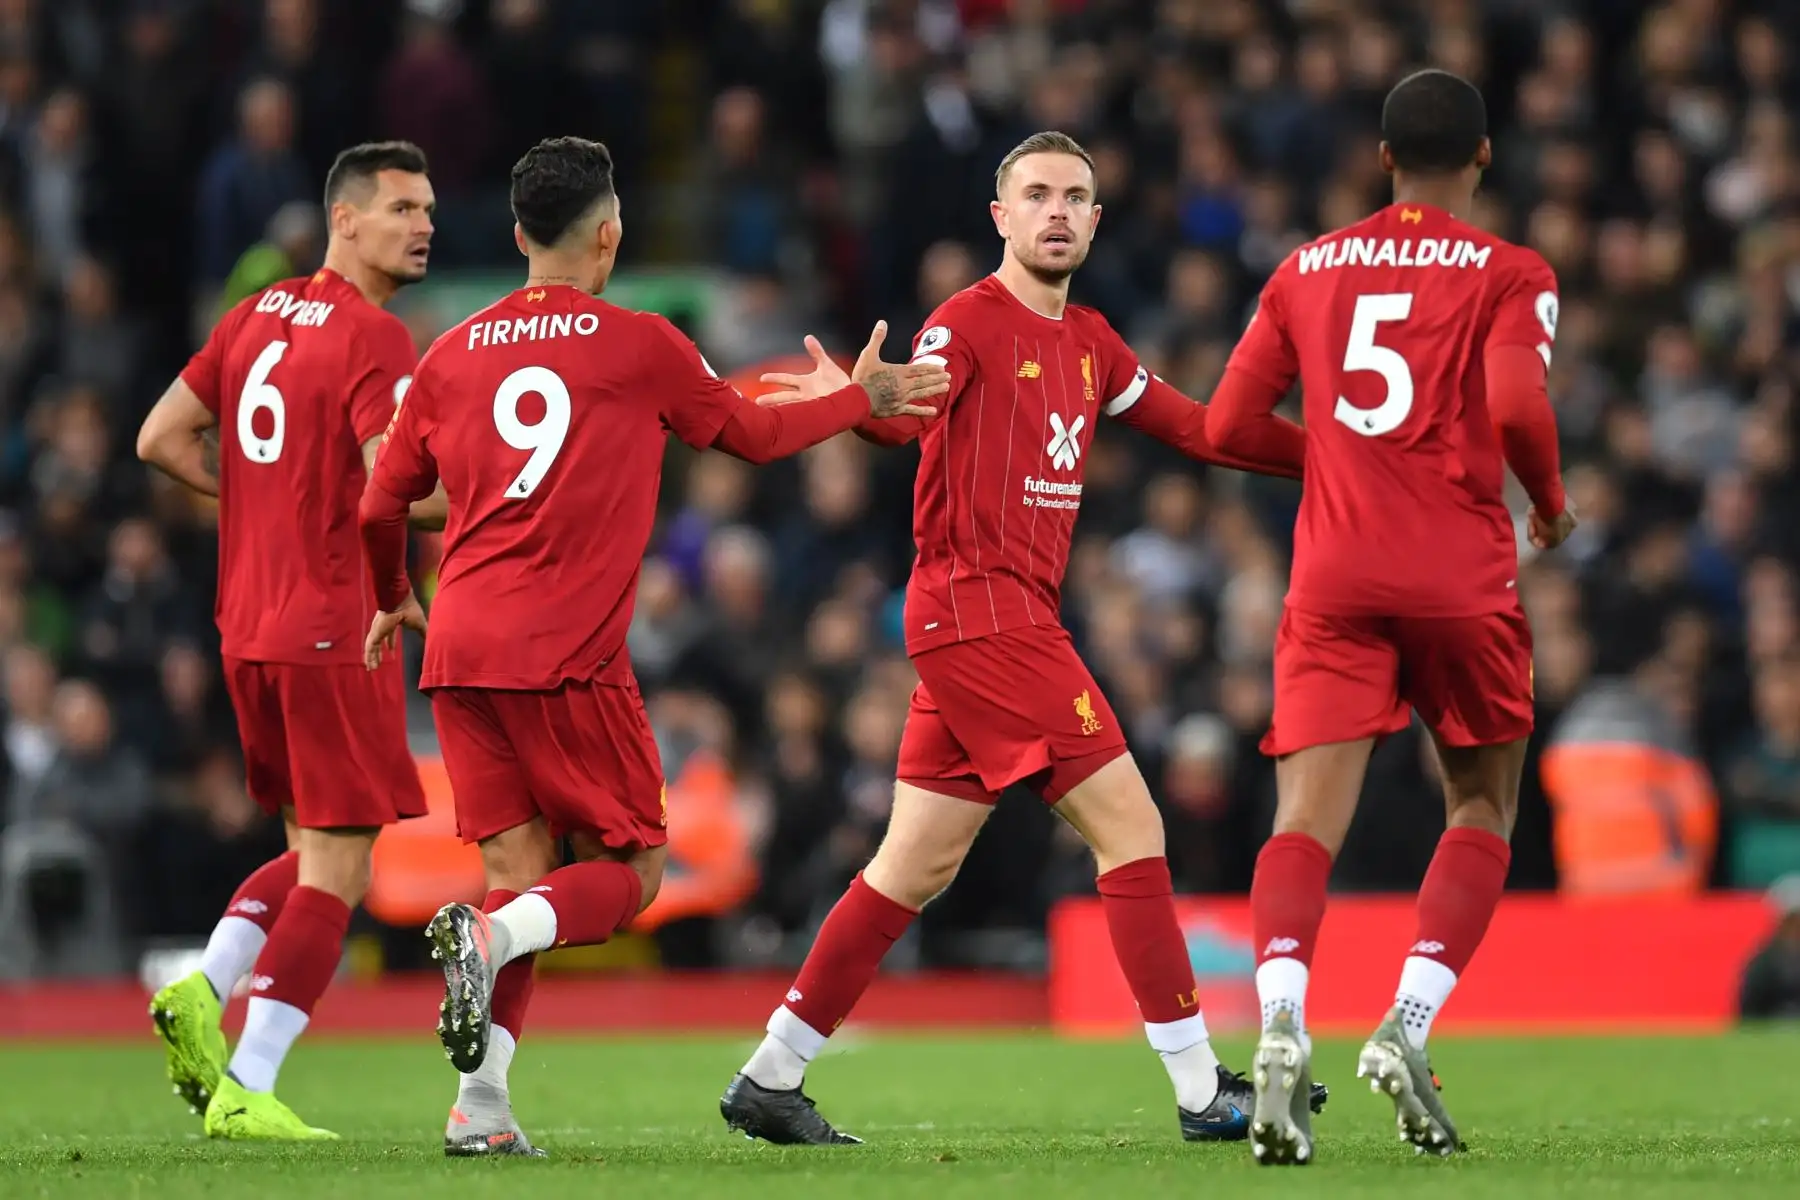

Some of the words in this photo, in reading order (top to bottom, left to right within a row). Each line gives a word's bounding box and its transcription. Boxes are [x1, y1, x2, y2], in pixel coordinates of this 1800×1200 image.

[1299, 237, 1492, 275] WIJNALDUM
[467, 313, 599, 351] FIRMINO
[1333, 292, 1414, 437] 5
[237, 340, 288, 463] 6
[493, 365, 572, 498] 9
[1022, 494, 1035, 508] by
